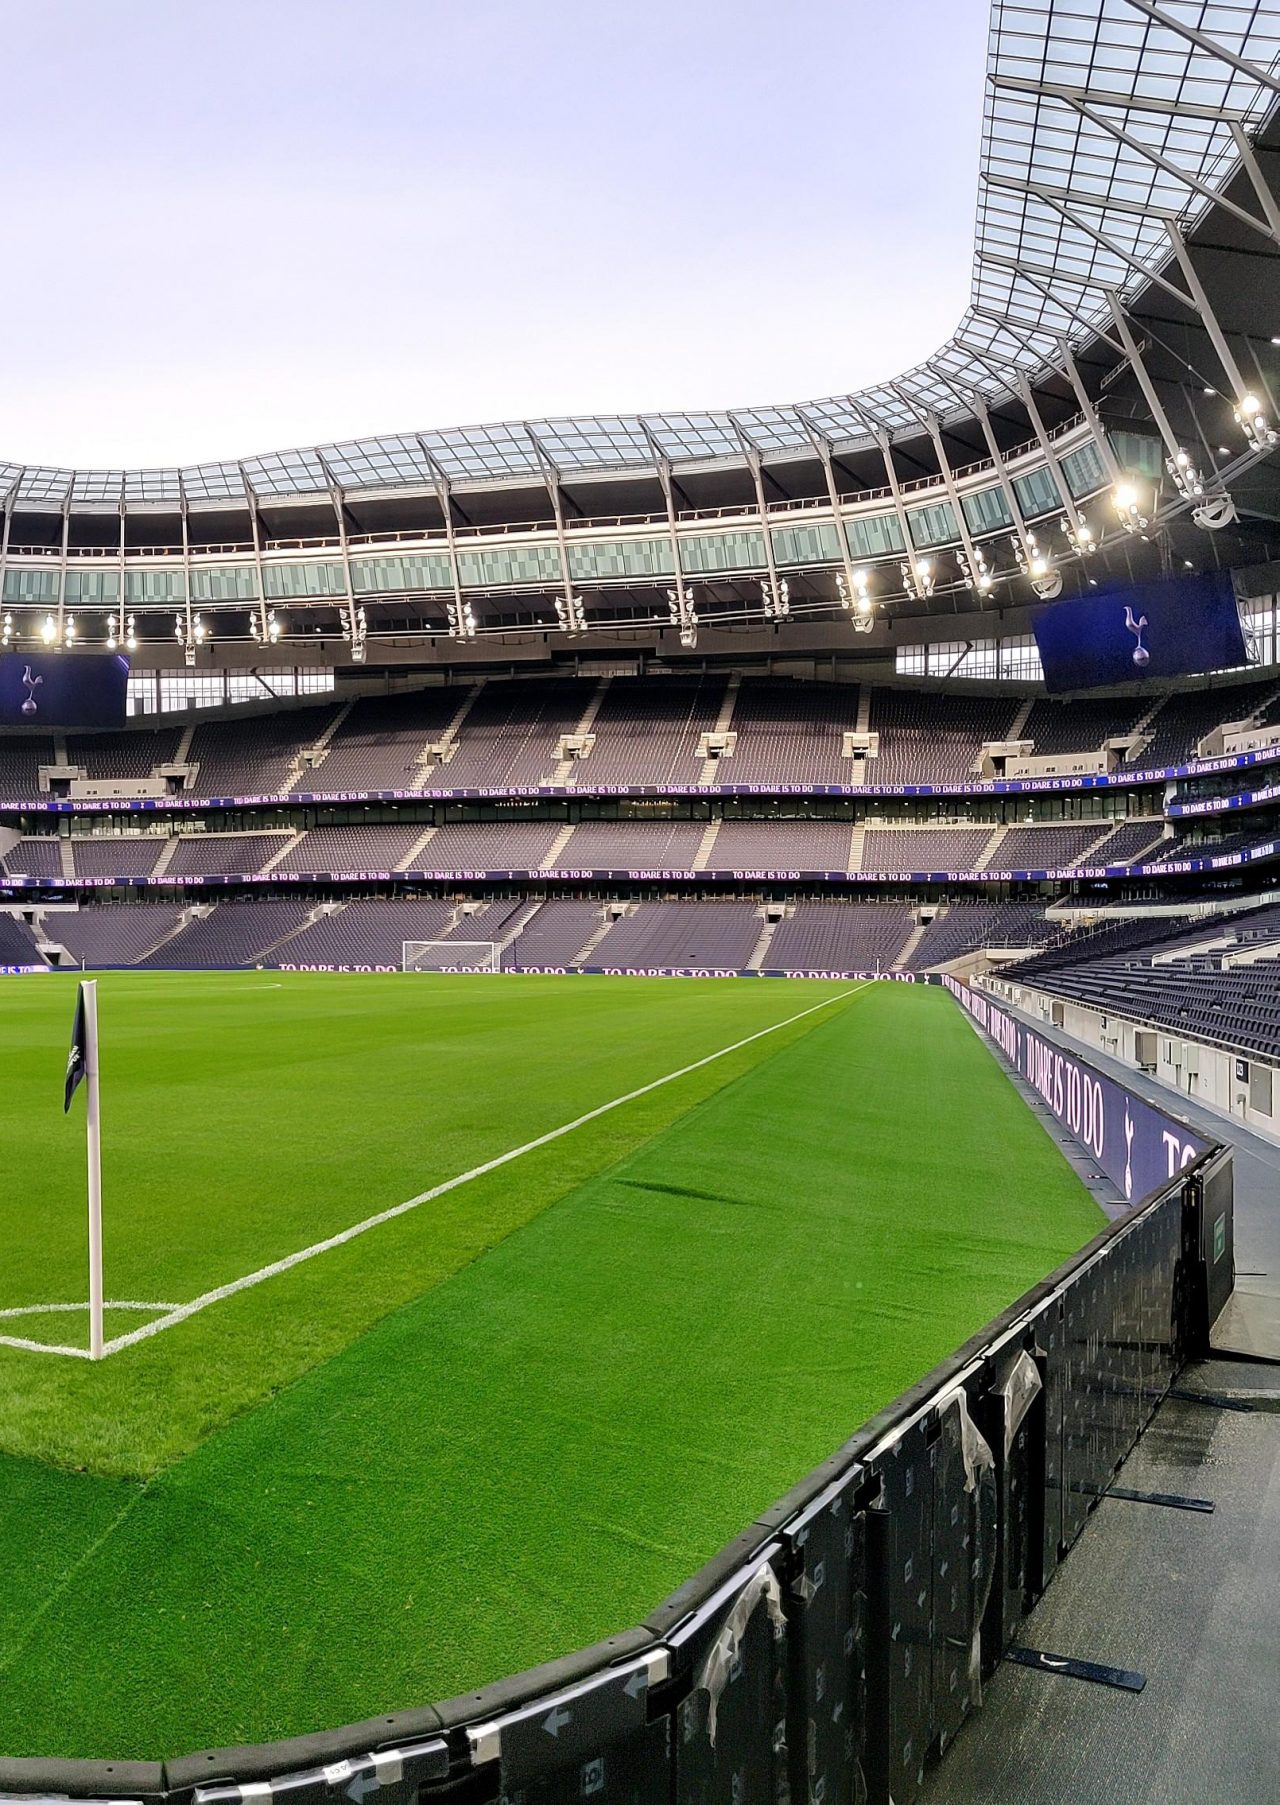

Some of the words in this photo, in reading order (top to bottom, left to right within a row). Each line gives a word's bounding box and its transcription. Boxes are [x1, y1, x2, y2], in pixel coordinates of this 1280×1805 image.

[1108, 775, 1117, 786] TO
[1118, 773, 1135, 784] DARE
[1137, 772, 1143, 783] IS
[1145, 771, 1153, 782] TO
[1155, 770, 1164, 781] DO
[1142, 865, 1151, 874] TO
[1152, 864, 1167, 874] DARE
[1168, 864, 1173, 873] IS
[1175, 863, 1182, 872] TO
[1183, 862, 1192, 872] DO
[629, 870, 639, 879] TO
[641, 870, 661, 879] DARE
[663, 870, 670, 879] IS
[672, 870, 682, 879] TO
[684, 870, 695, 879] DO
[846, 872, 855, 881] TO
[857, 873, 877, 882] DARE
[879, 873, 886, 882] IS
[889, 874, 898, 882] TO
[900, 874, 911, 882] DO
[809, 972, 848, 981] DARE
[854, 973, 866, 981] IS
[872, 973, 891, 982] TO
[896, 973, 915, 983] DO
[1026, 1033, 1035, 1084] TO
[1035, 1040, 1053, 1106] DARE
[1054, 1055, 1063, 1116] IS
[1066, 1062, 1080, 1134] TO
[1084, 1074, 1104, 1158] DO
[1163, 1130, 1196, 1178] T
